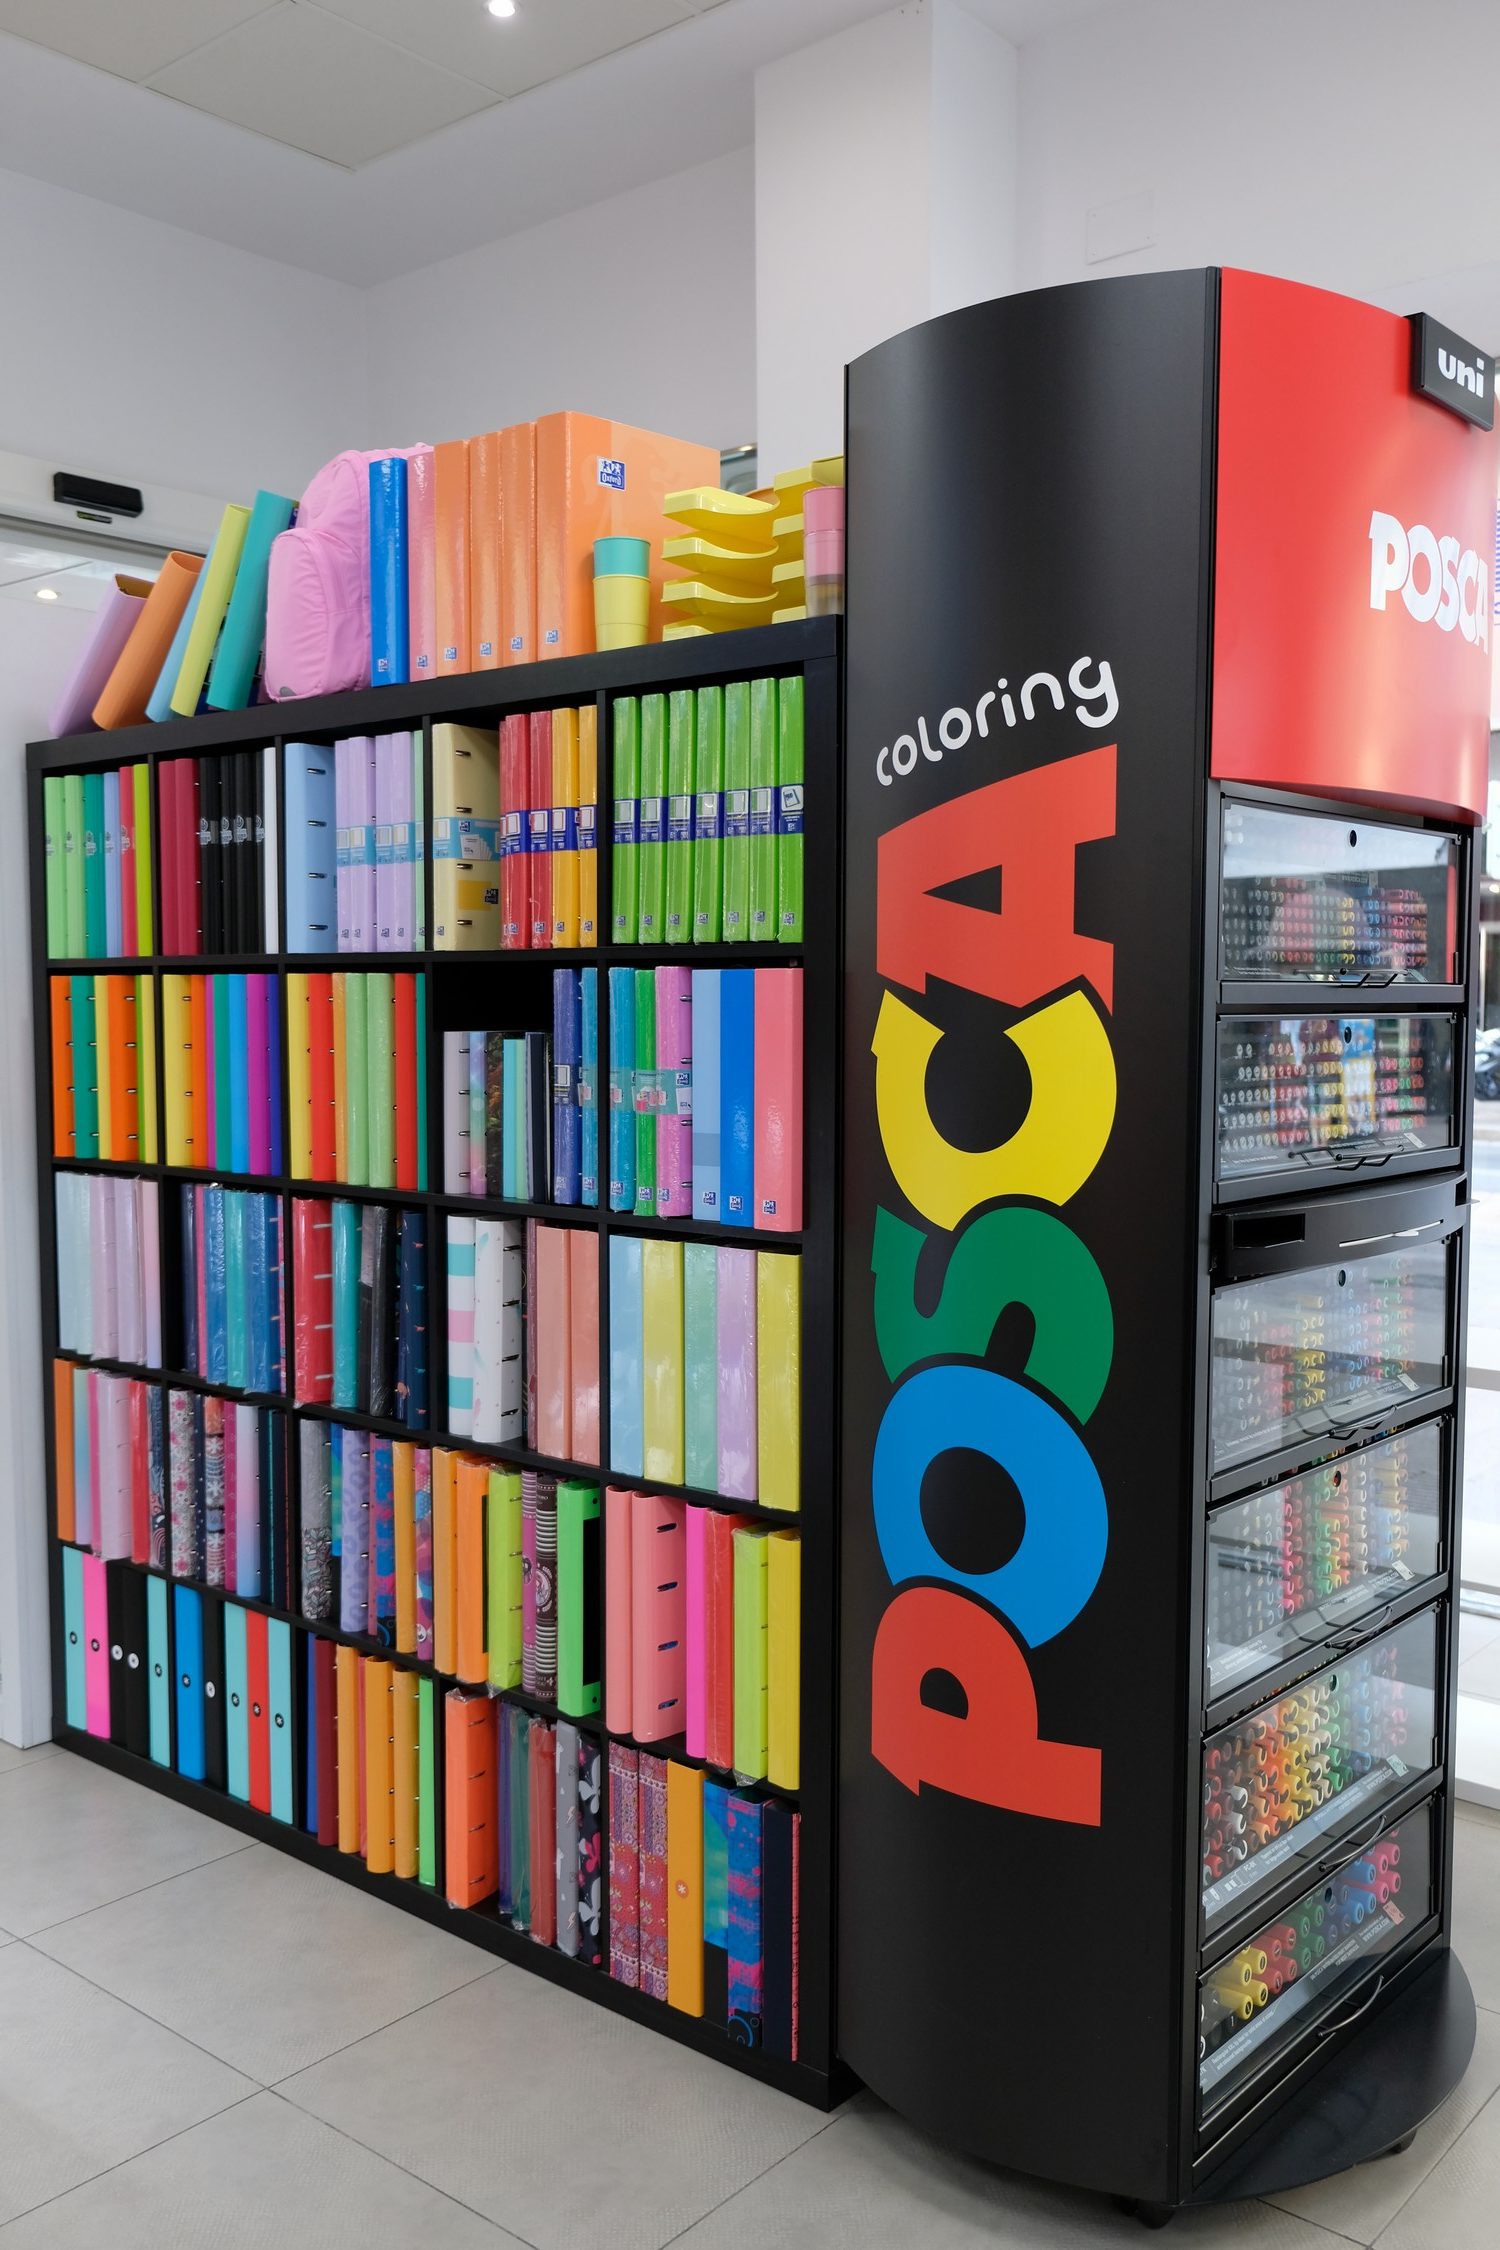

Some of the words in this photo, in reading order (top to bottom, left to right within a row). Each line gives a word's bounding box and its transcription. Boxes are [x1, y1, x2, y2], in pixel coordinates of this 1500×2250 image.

[1438, 347, 1485, 399] uni
[1368, 510, 1489, 656] POSCA
[876, 655, 1119, 786] coloring
[871, 743, 1118, 1827] POSCA
